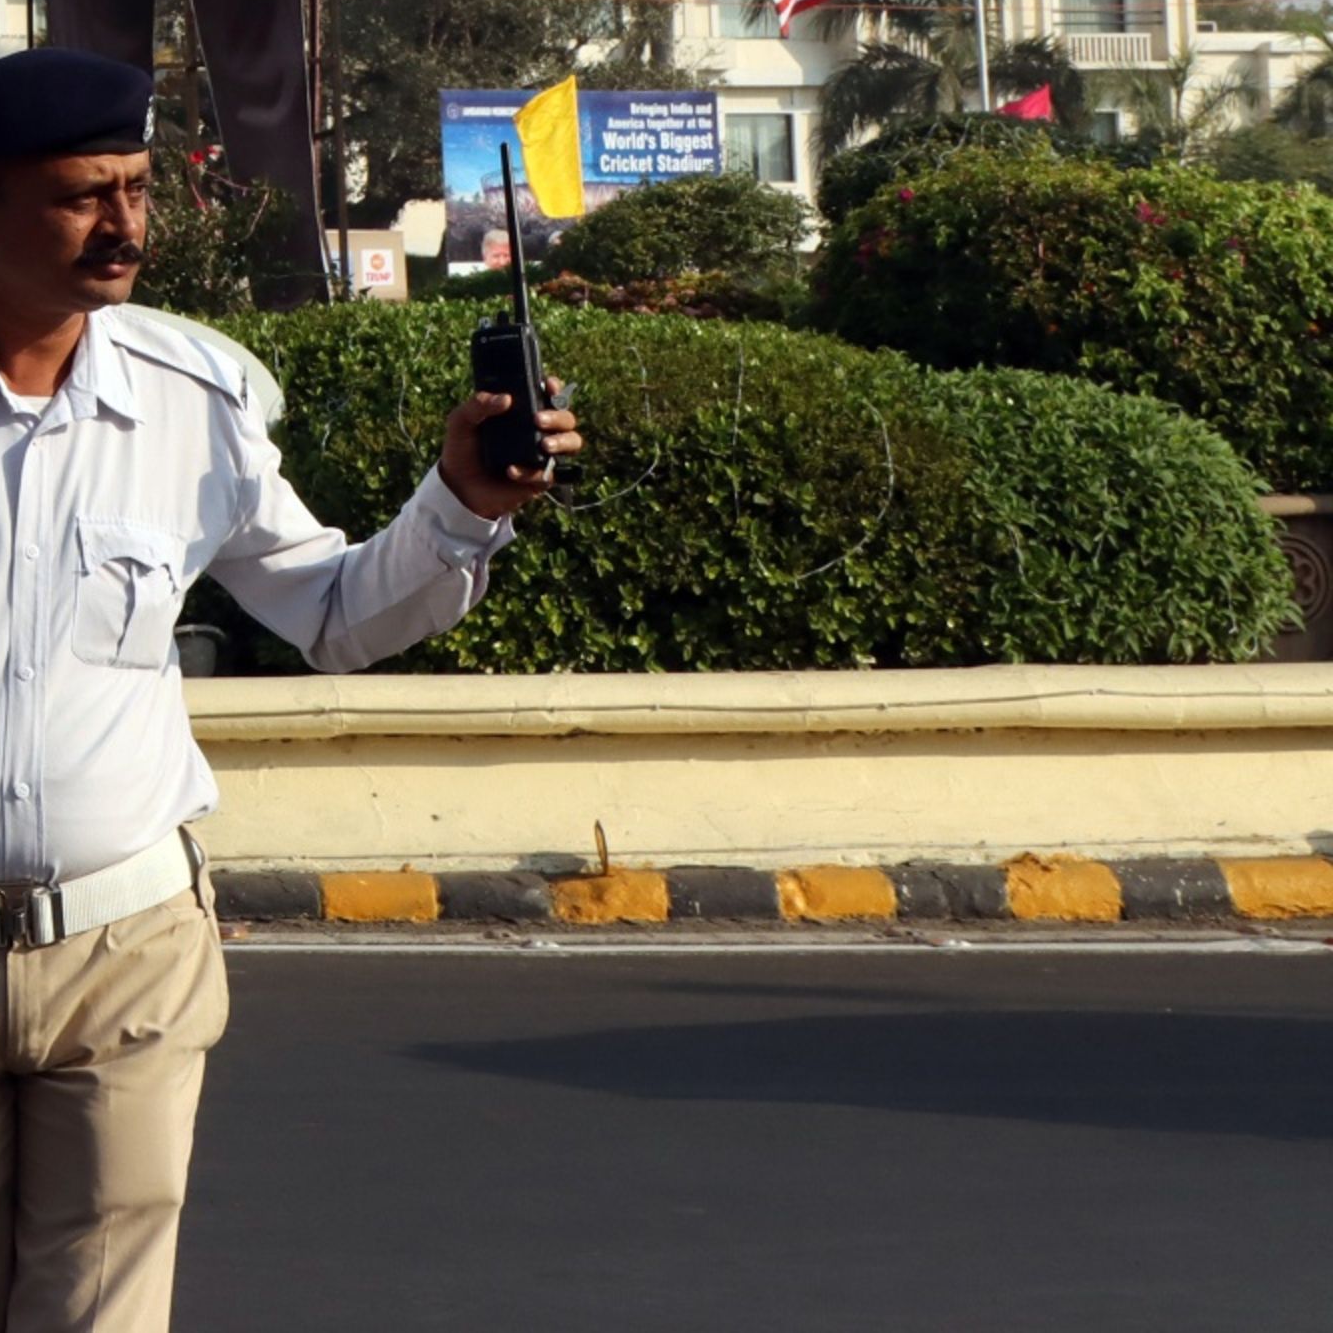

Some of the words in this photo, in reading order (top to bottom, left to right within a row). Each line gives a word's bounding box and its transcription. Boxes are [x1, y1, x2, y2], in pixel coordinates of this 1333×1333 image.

[602, 131, 656, 150] World's
[660, 131, 713, 154] Biggest
[600, 153, 653, 173] Cricket
